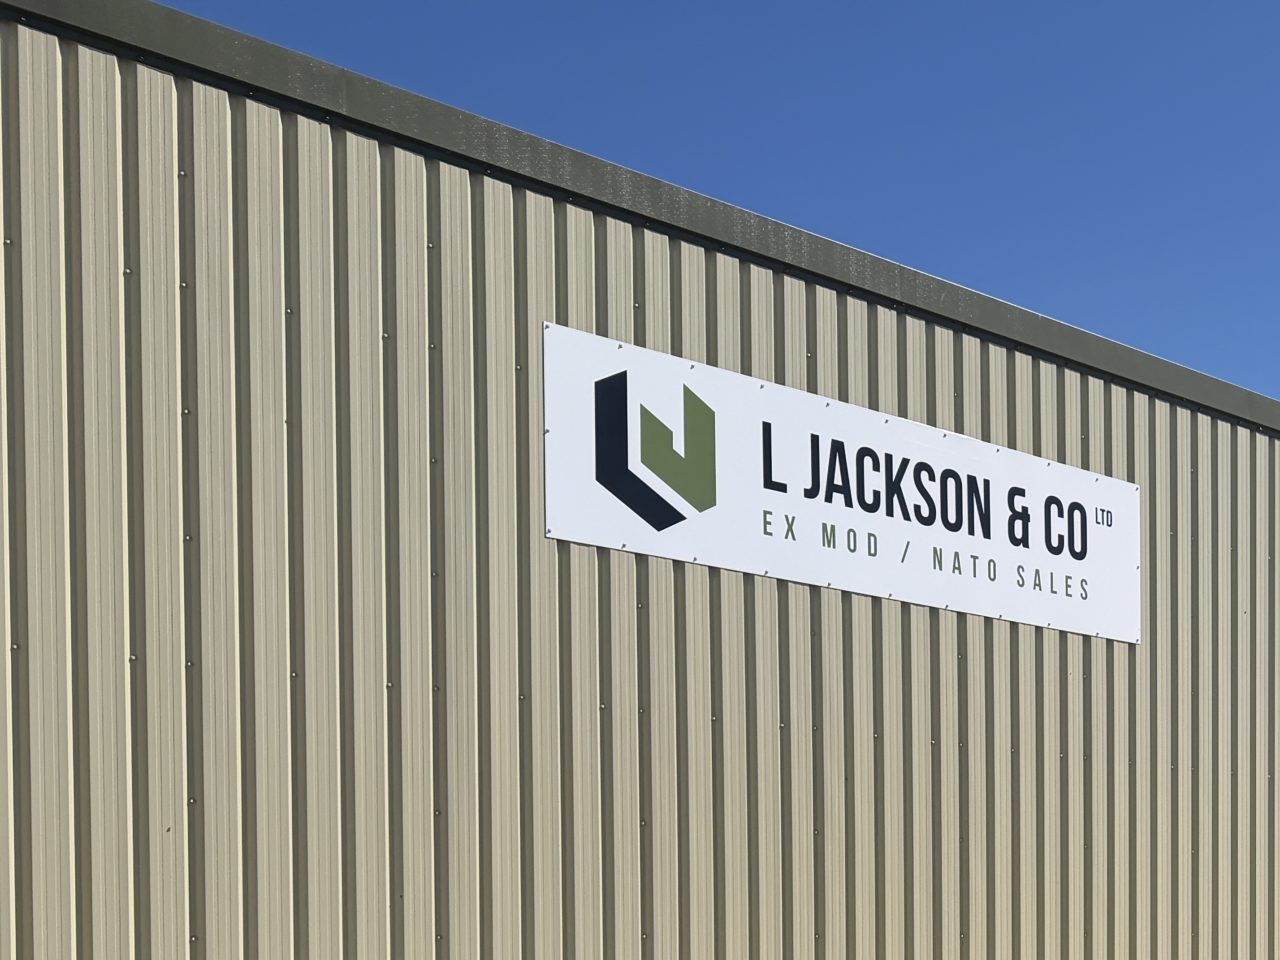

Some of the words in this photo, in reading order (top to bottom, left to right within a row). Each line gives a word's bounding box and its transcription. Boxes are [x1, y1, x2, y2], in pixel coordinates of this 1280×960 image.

[761, 420, 788, 494] L
[802, 433, 992, 541] JACKSON
[1007, 486, 1031, 550] &
[1043, 494, 1089, 562] CO
[1095, 506, 1114, 529] LTD
[762, 509, 797, 542] EX
[821, 523, 879, 559] MOD
[931, 547, 999, 583] NATO
[1015, 564, 1090, 602] SALES
